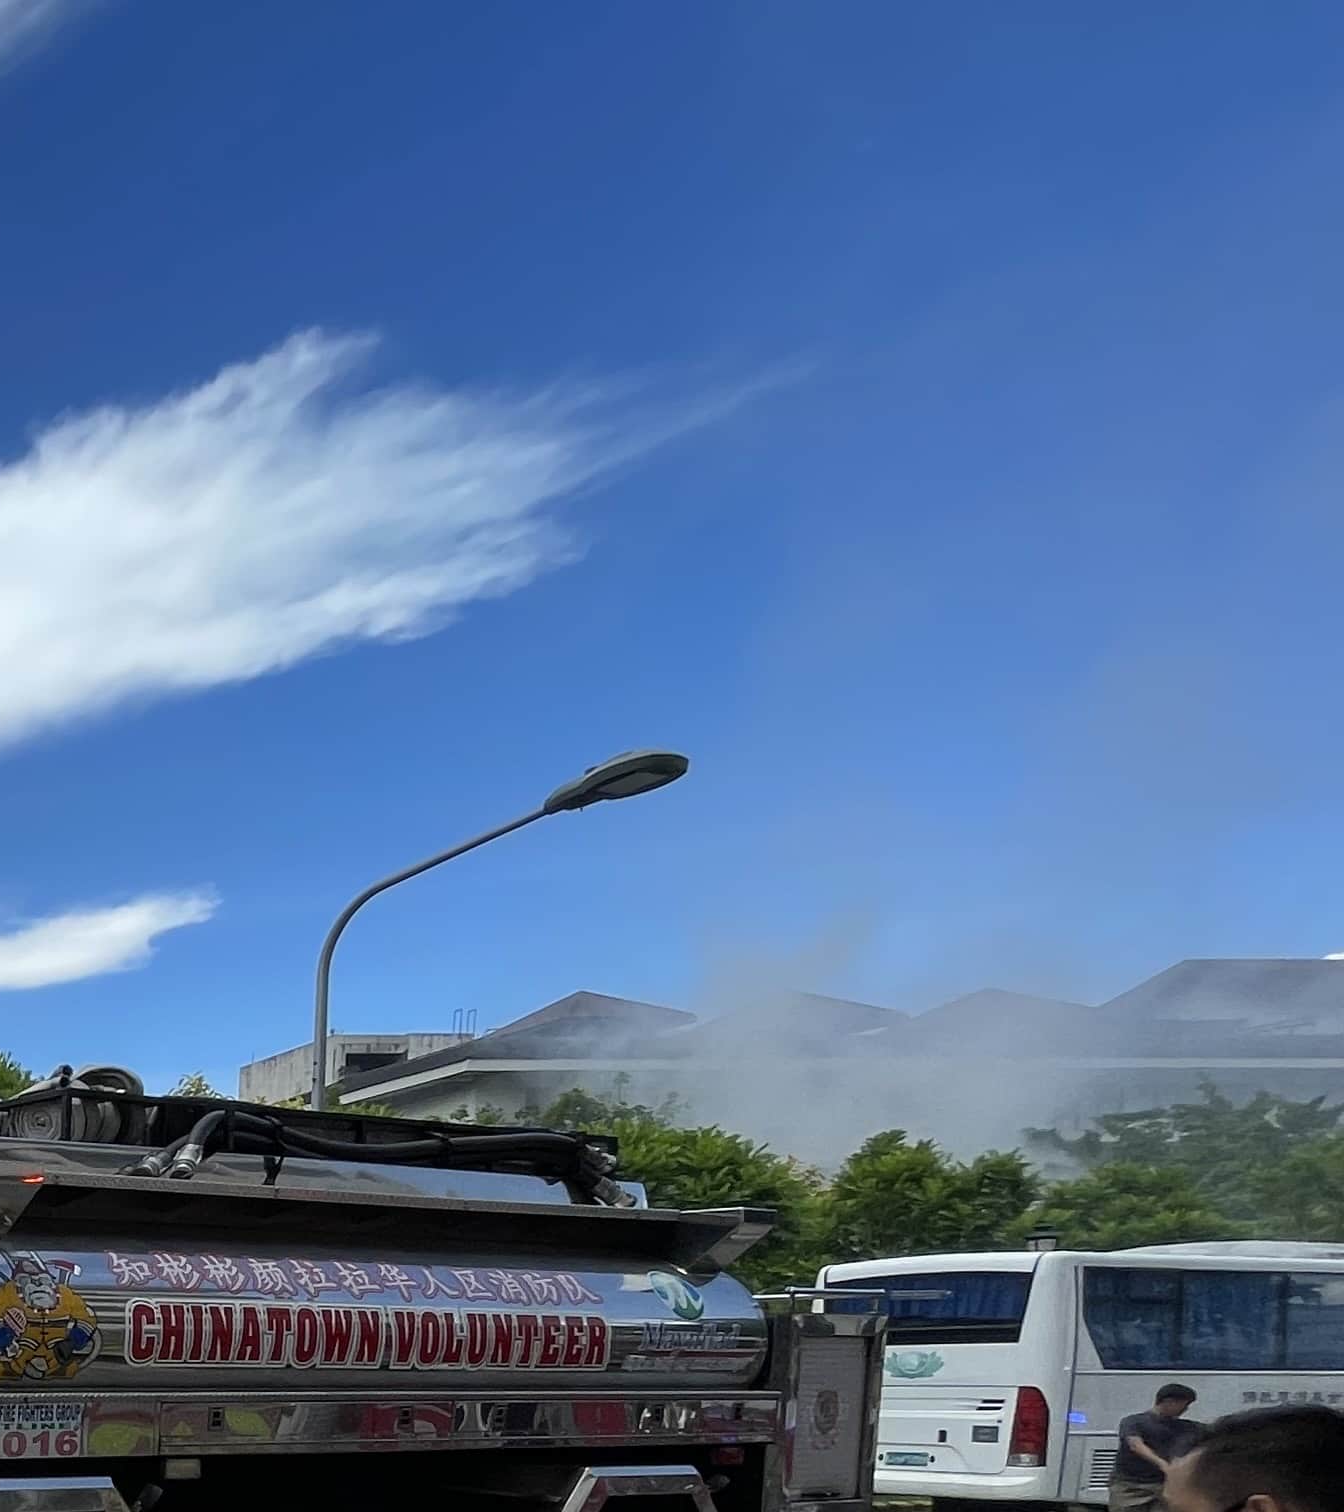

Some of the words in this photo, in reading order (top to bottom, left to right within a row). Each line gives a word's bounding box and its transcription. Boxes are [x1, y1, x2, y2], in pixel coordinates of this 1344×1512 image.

[129, 1302, 382, 1366] CHINATOWN
[393, 1309, 607, 1368] VOLUNTEER
[0, 1405, 16, 1422] FIRE
[55, 1404, 81, 1421] GROUP
